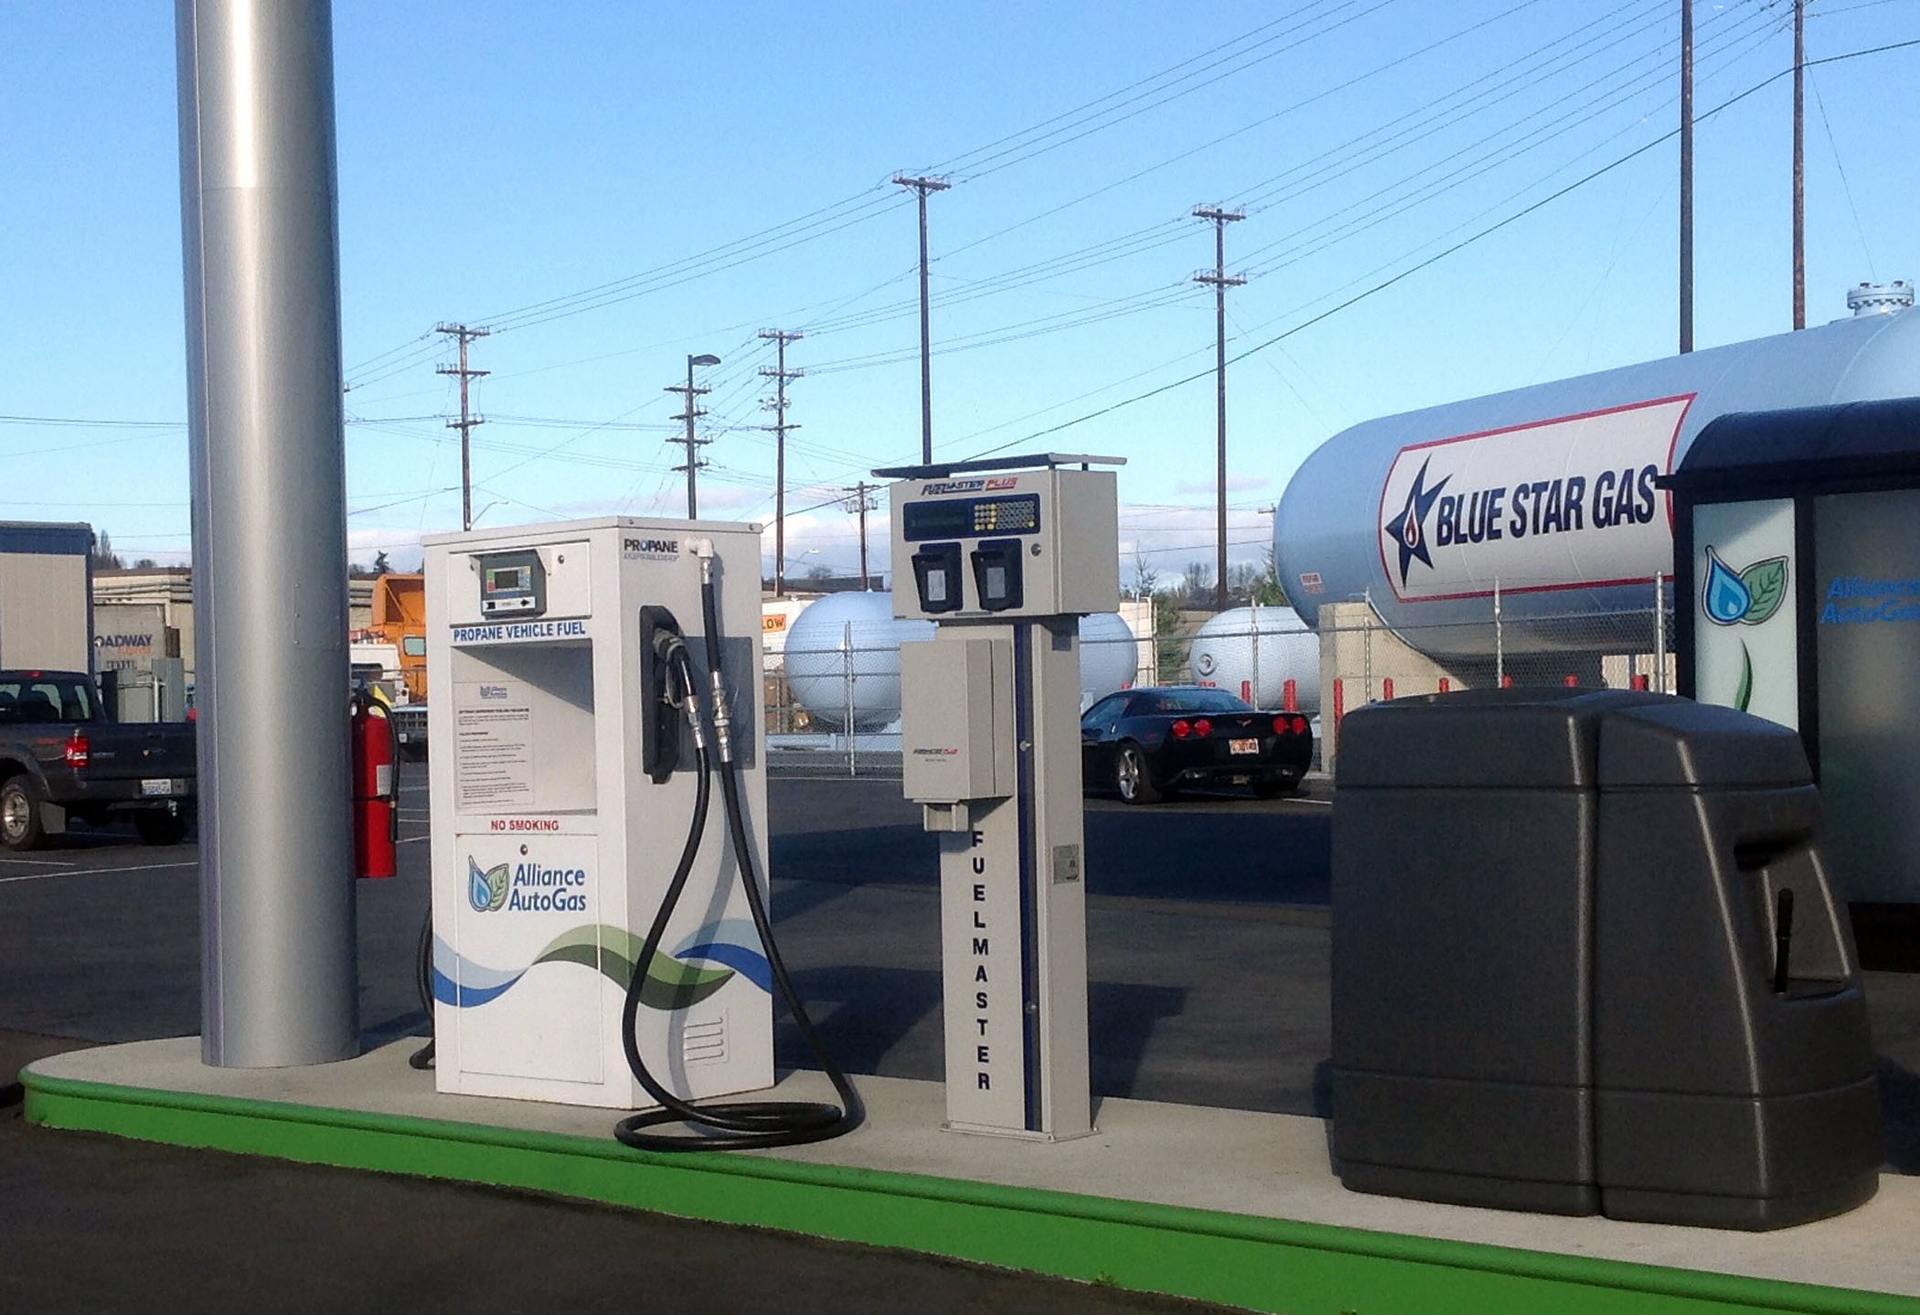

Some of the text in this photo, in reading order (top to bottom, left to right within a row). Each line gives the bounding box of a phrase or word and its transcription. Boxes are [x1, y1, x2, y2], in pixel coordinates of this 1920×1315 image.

[985, 477, 1017, 491] PLUS
[1436, 464, 1659, 547] BLUE STAR GAS
[624, 538, 678, 553] PROPANE
[453, 621, 586, 642] PROPANE VEHICLE FUEL
[491, 820, 559, 831] NO SMOKING
[513, 863, 585, 887] Alliance
[508, 888, 587, 911] AutoGas
[972, 830, 991, 1091] FUELMASTER
